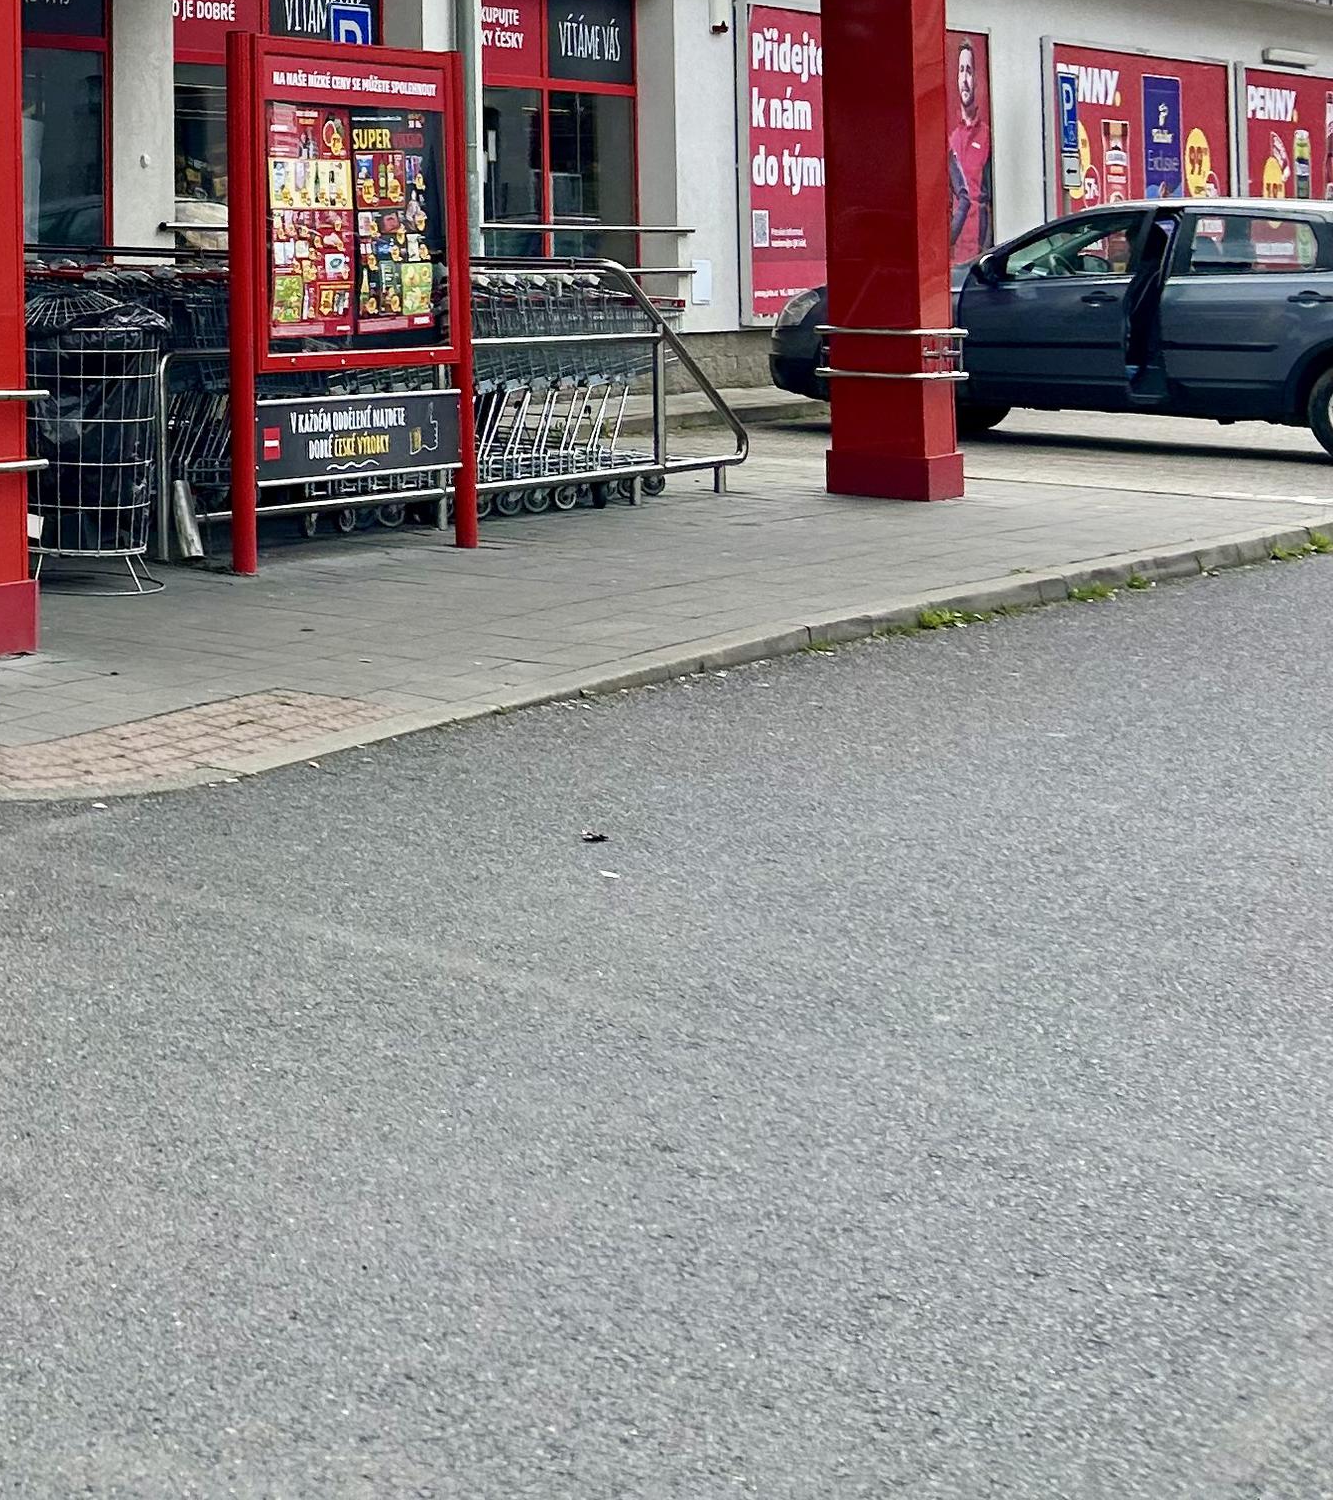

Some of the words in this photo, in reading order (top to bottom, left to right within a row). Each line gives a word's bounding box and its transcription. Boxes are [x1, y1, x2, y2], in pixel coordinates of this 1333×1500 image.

[182, 0, 194, 21] JE
[494, 27, 524, 49] ČESKY
[558, 13, 601, 60] VÍTÁME
[601, 18, 621, 62] VÁS
[272, 71, 285, 86] NA
[286, 69, 308, 87] NAŠE
[308, 70, 331, 88] NÍZKÉ
[332, 74, 352, 90] CENY
[352, 77, 362, 91] SE
[362, 74, 391, 94] MŮŽETE
[391, 81, 436, 97] SPOLEHNOUT
[1056, 62, 1121, 108] NNY.
[752, 86, 766, 128] k
[770, 86, 813, 131] nám
[1061, 82, 1074, 127] P
[352, 128, 392, 150] SUPER
[752, 144, 779, 186] do
[290, 411, 296, 434] V
[297, 404, 331, 434] KAŽDÉM
[332, 404, 371, 431] ODDĚLENÍ
[373, 406, 406, 428] NAJDETE
[308, 434, 333, 460] DOBRÉ
[333, 432, 357, 457] ČESKÉ
[357, 430, 390, 455] VÝROBKY
